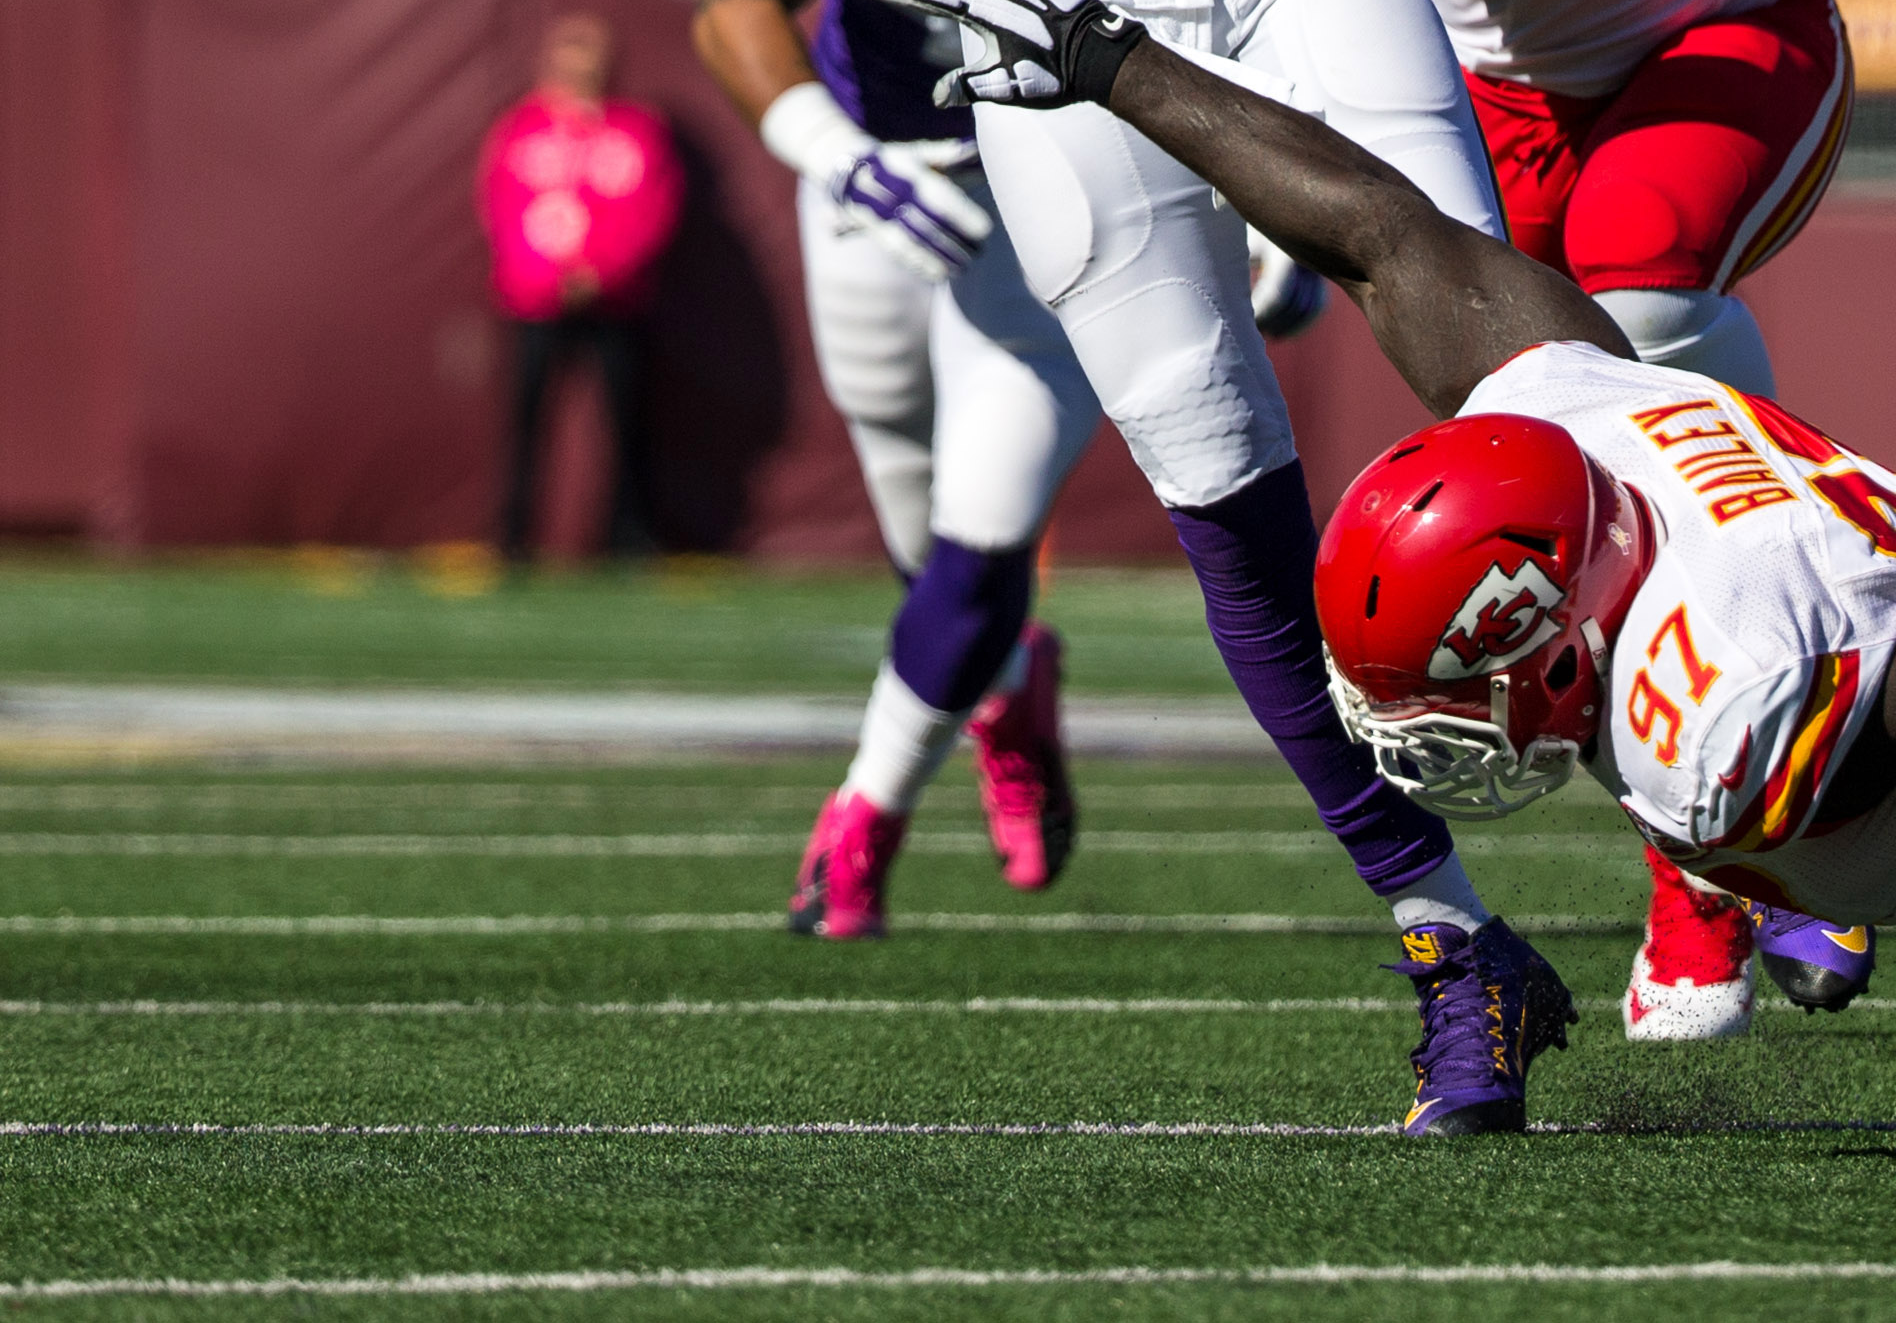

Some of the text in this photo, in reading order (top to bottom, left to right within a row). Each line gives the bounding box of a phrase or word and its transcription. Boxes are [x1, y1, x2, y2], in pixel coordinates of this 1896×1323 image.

[1627, 398, 1799, 527] BAILEY
[1443, 586, 1547, 670] KC
[1627, 601, 1722, 767] 97
